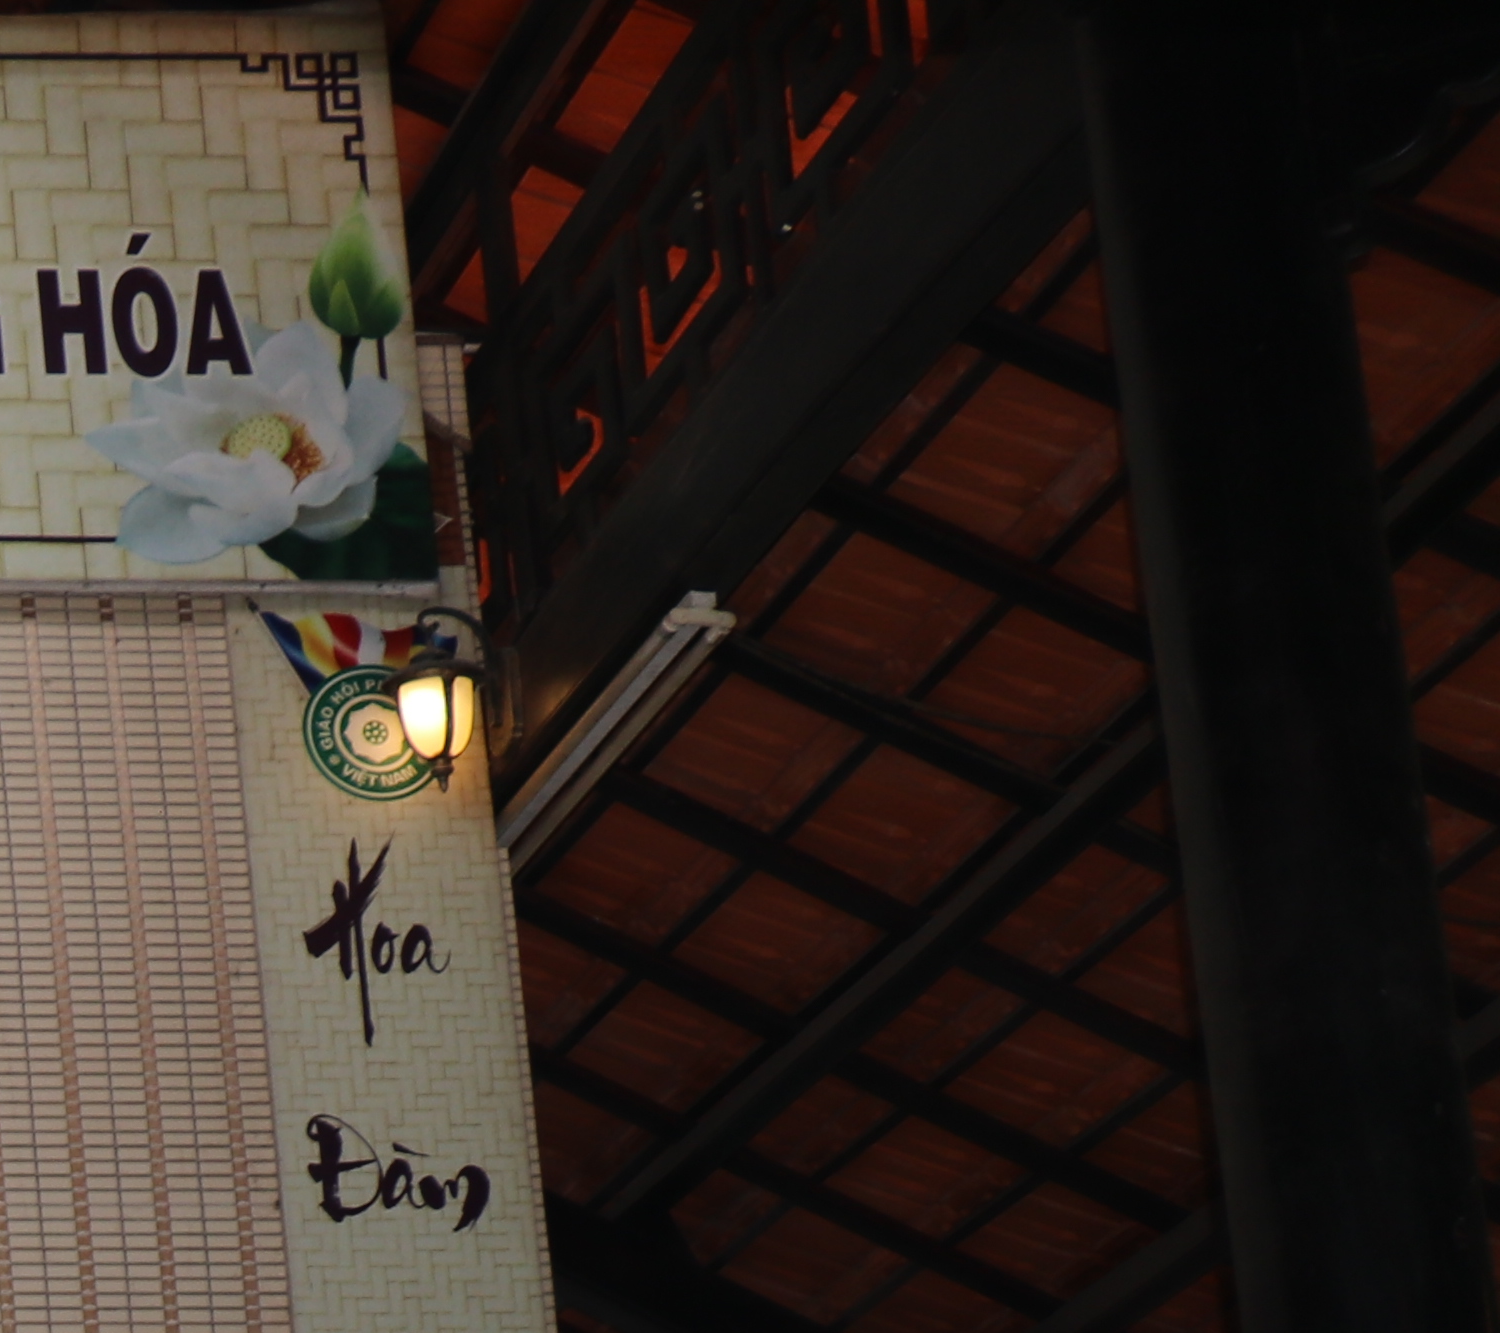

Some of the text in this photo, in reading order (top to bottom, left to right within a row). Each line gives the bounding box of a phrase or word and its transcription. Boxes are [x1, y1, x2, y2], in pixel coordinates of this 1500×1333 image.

[36, 232, 252, 377] HÓA
[380, 764, 418, 787] NAM
[303, 829, 452, 1048] Hoa
[307, 1113, 490, 1233] Đàm
